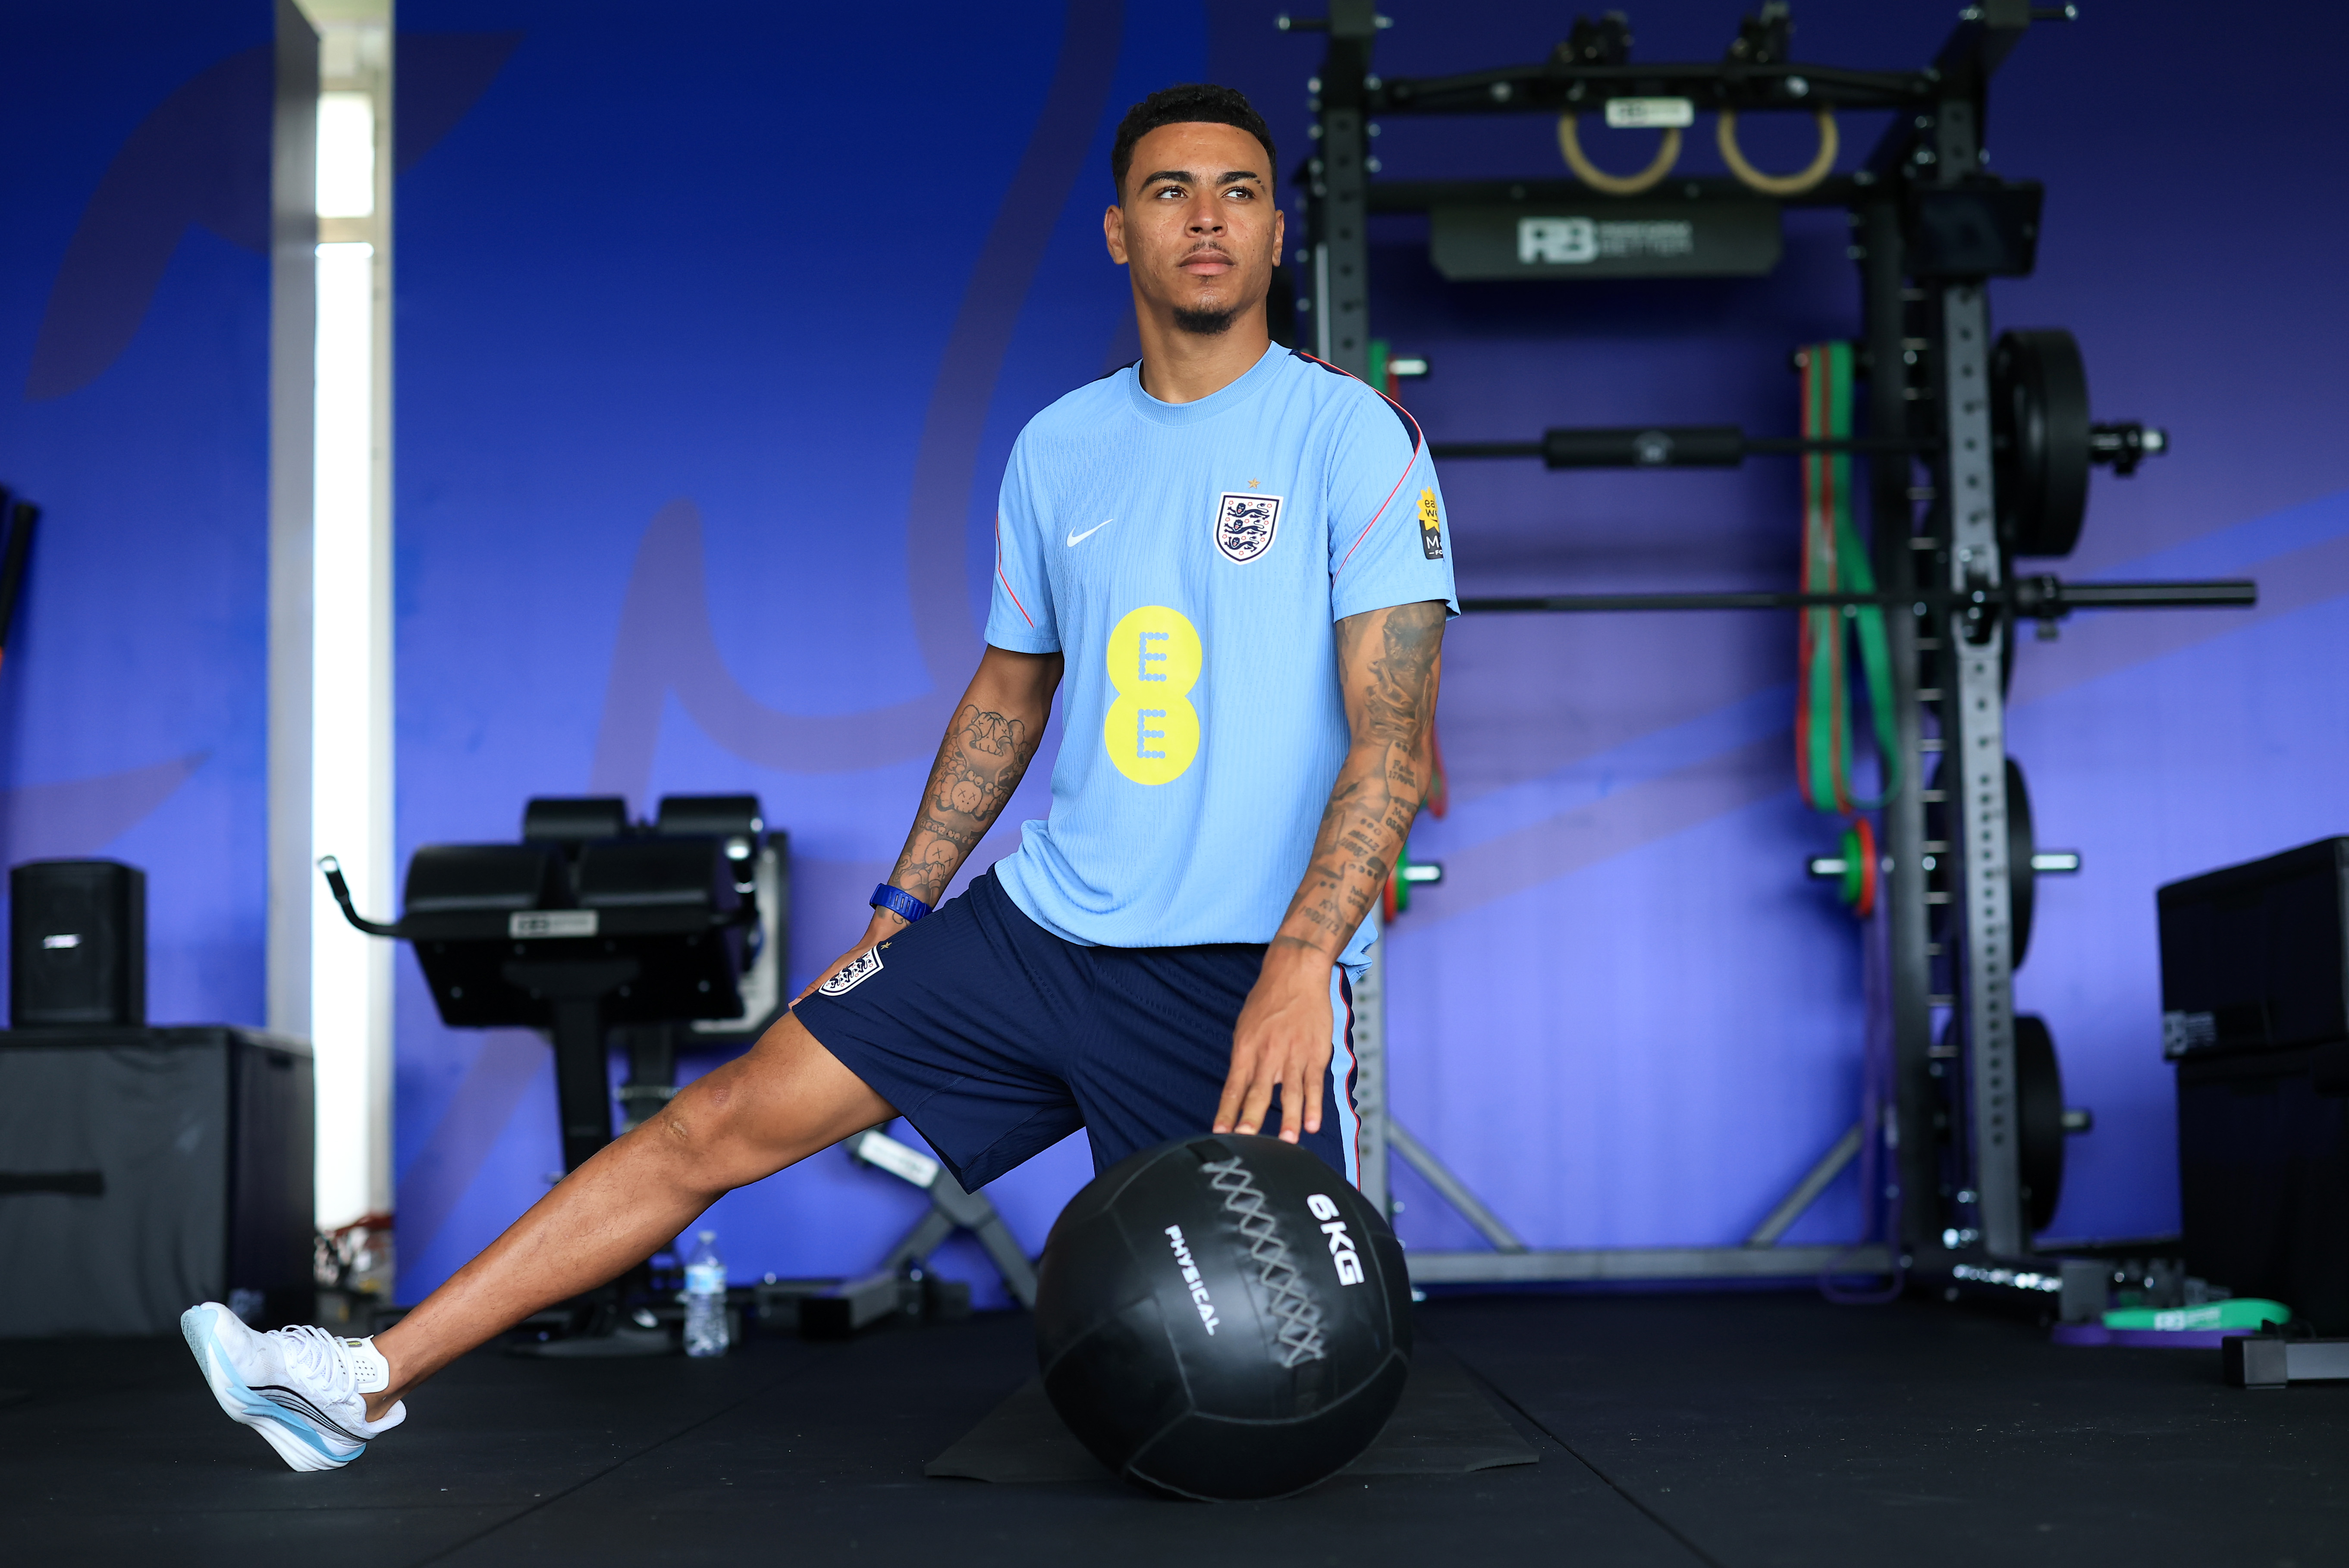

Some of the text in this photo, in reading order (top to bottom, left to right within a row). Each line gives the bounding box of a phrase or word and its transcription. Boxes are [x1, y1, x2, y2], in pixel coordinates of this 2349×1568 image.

[1426, 535, 1441, 549] M
[1165, 1224, 1220, 1336] PHYSICAL
[1306, 1194, 1365, 1286] 6KG
